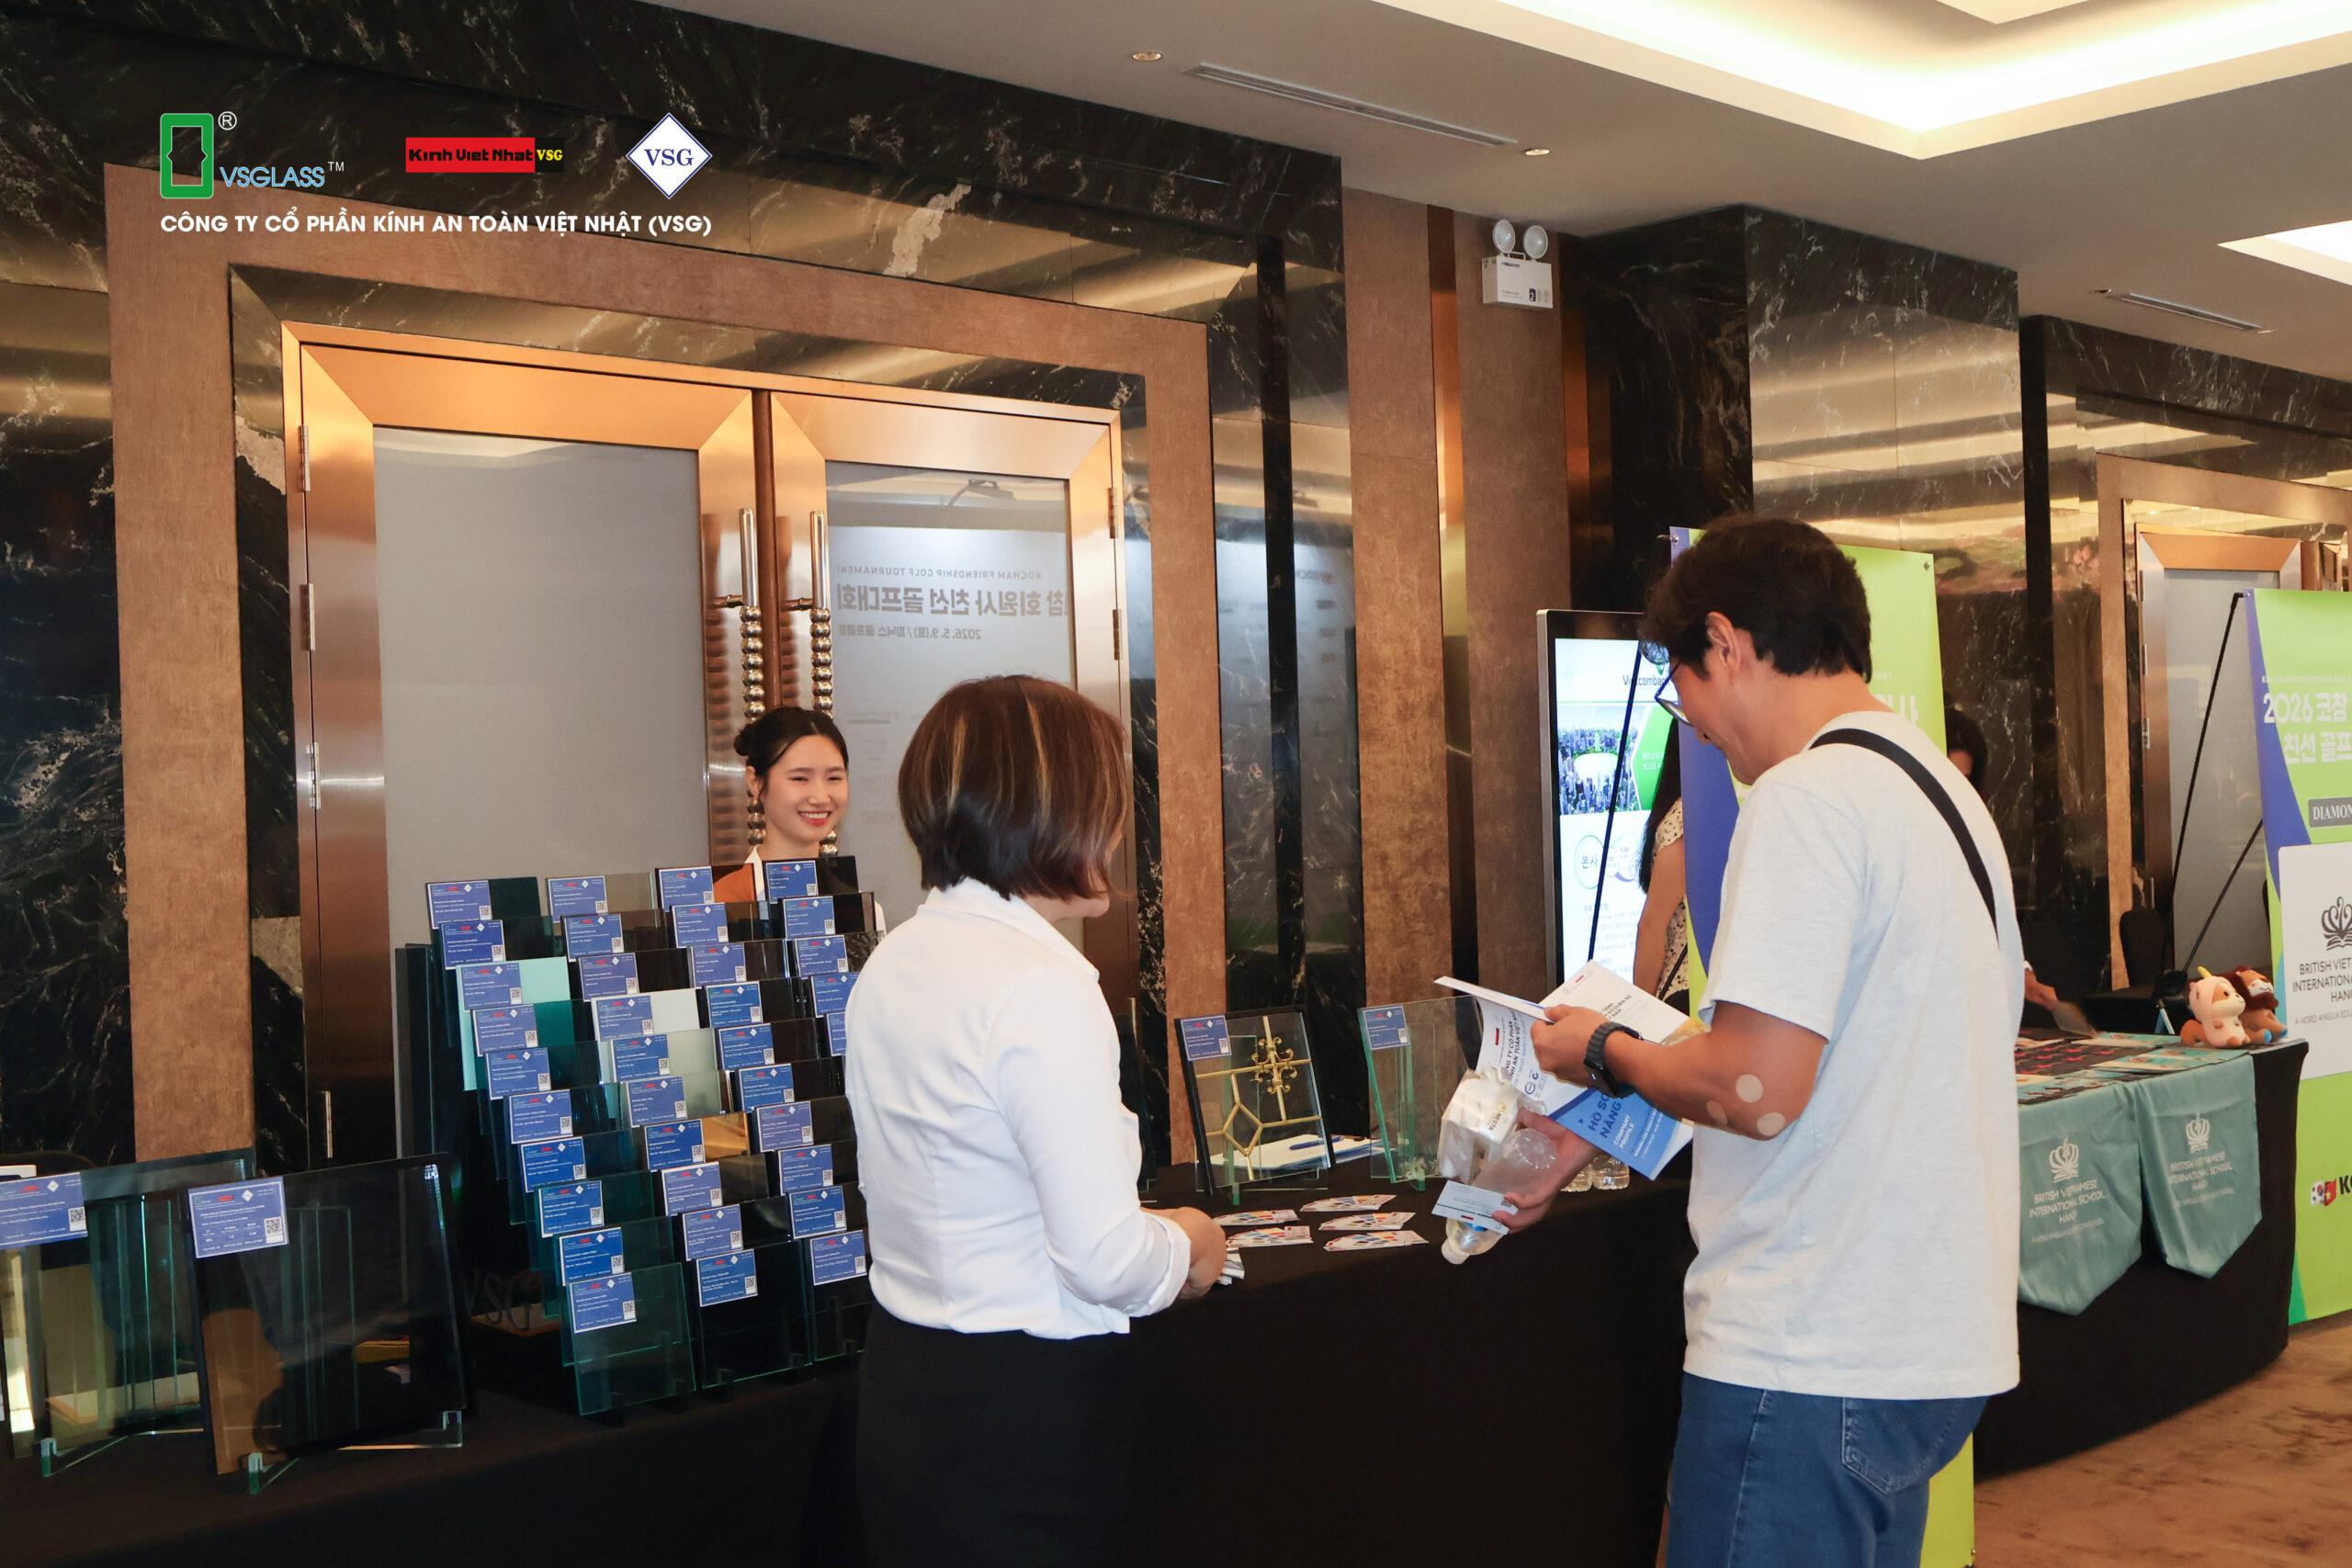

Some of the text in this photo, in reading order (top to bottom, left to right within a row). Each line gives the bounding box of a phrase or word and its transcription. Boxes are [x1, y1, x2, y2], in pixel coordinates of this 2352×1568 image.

[2263, 691, 2348, 724] 2026 코참
[2282, 732, 2316, 764] 친선
[1581, 854, 1599, 869] 본사
[2300, 961, 2331, 975] BRITISH
[2331, 990, 2352, 1002] HAN
[2339, 1175, 2352, 1195] K
